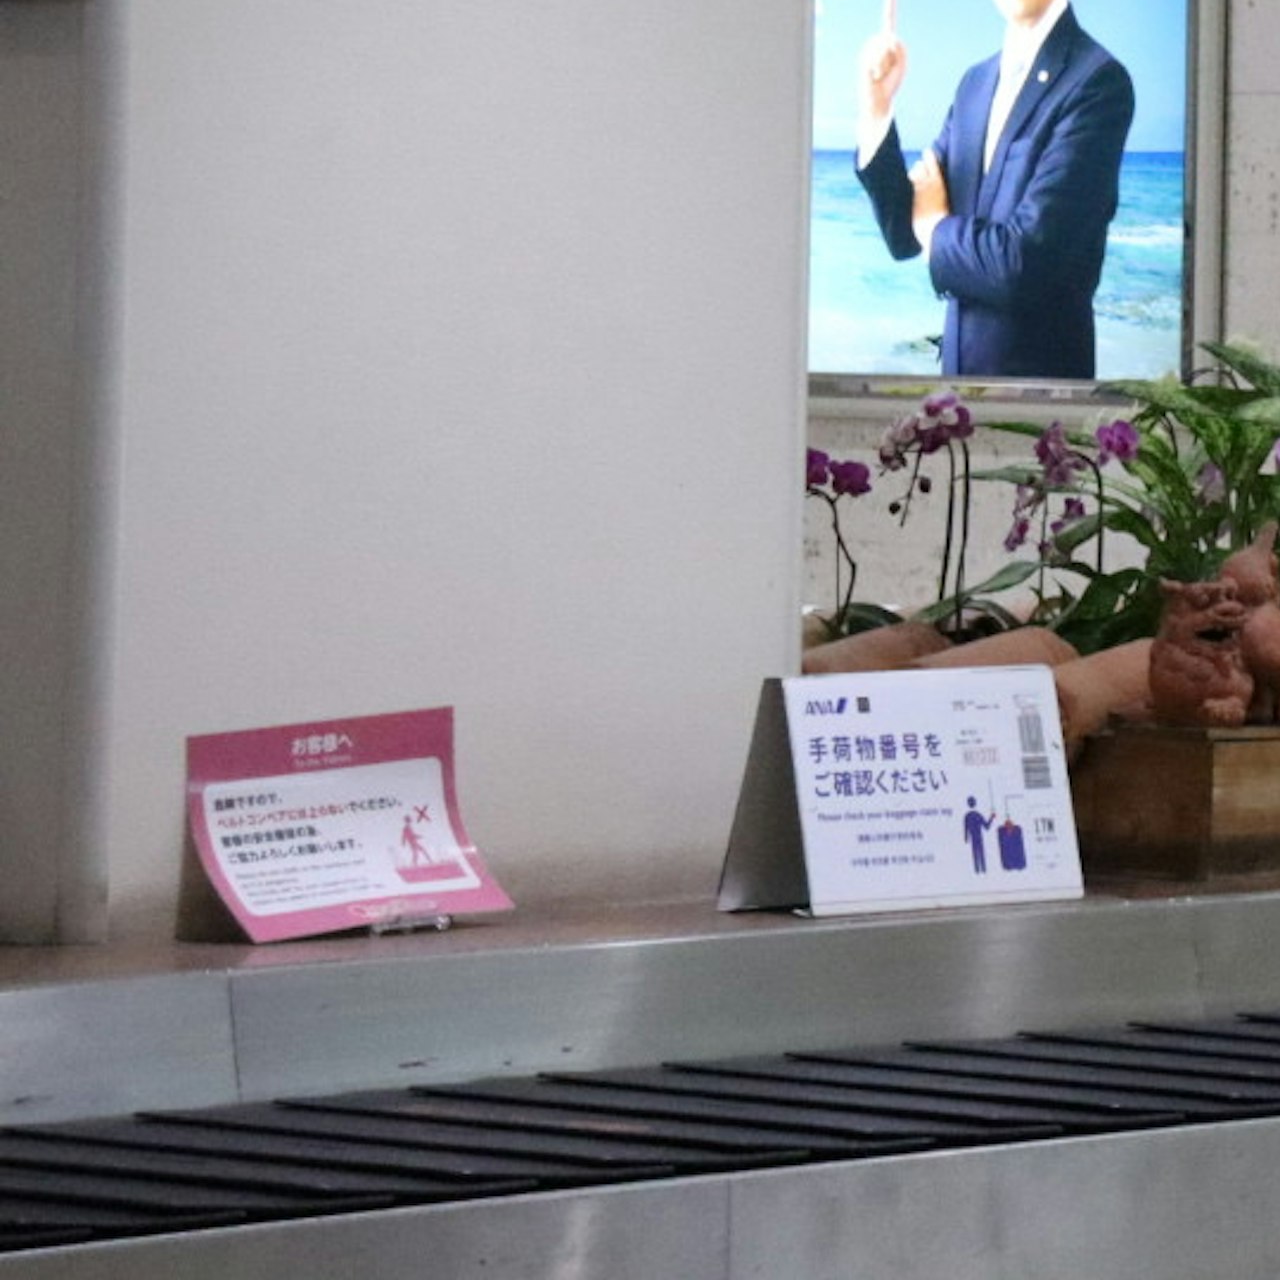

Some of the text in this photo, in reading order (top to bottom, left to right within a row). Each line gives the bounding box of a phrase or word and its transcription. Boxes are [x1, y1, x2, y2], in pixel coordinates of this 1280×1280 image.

[805, 697, 838, 715] ANA
[291, 732, 354, 756] お客様へ
[807, 733, 943, 764] 手荷物番号を
[814, 768, 949, 798] ご確認ください
